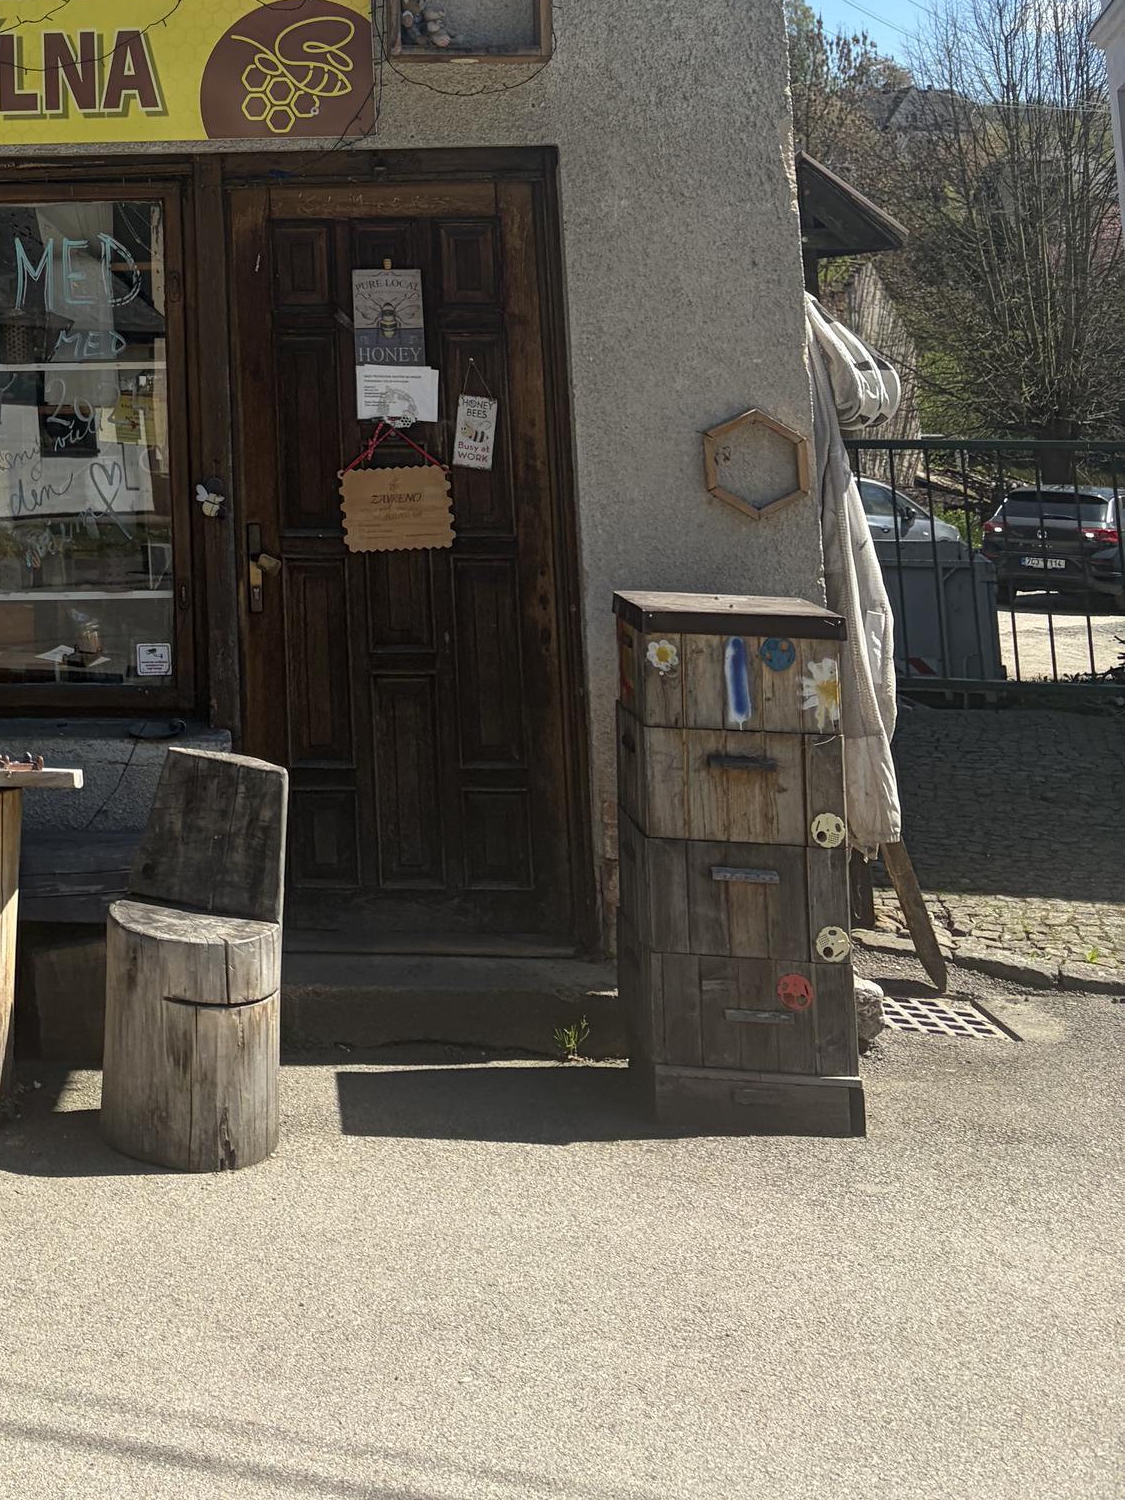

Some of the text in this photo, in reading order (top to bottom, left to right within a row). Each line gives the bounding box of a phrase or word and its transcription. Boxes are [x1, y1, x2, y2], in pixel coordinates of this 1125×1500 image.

[14, 232, 142, 311] MED
[354, 279, 419, 293] PURE LOCAL
[47, 330, 127, 362] MED
[358, 346, 423, 363] HONEY
[462, 398, 493, 411] HONEY
[466, 408, 488, 419] BEES
[458, 451, 489, 463] WORK
